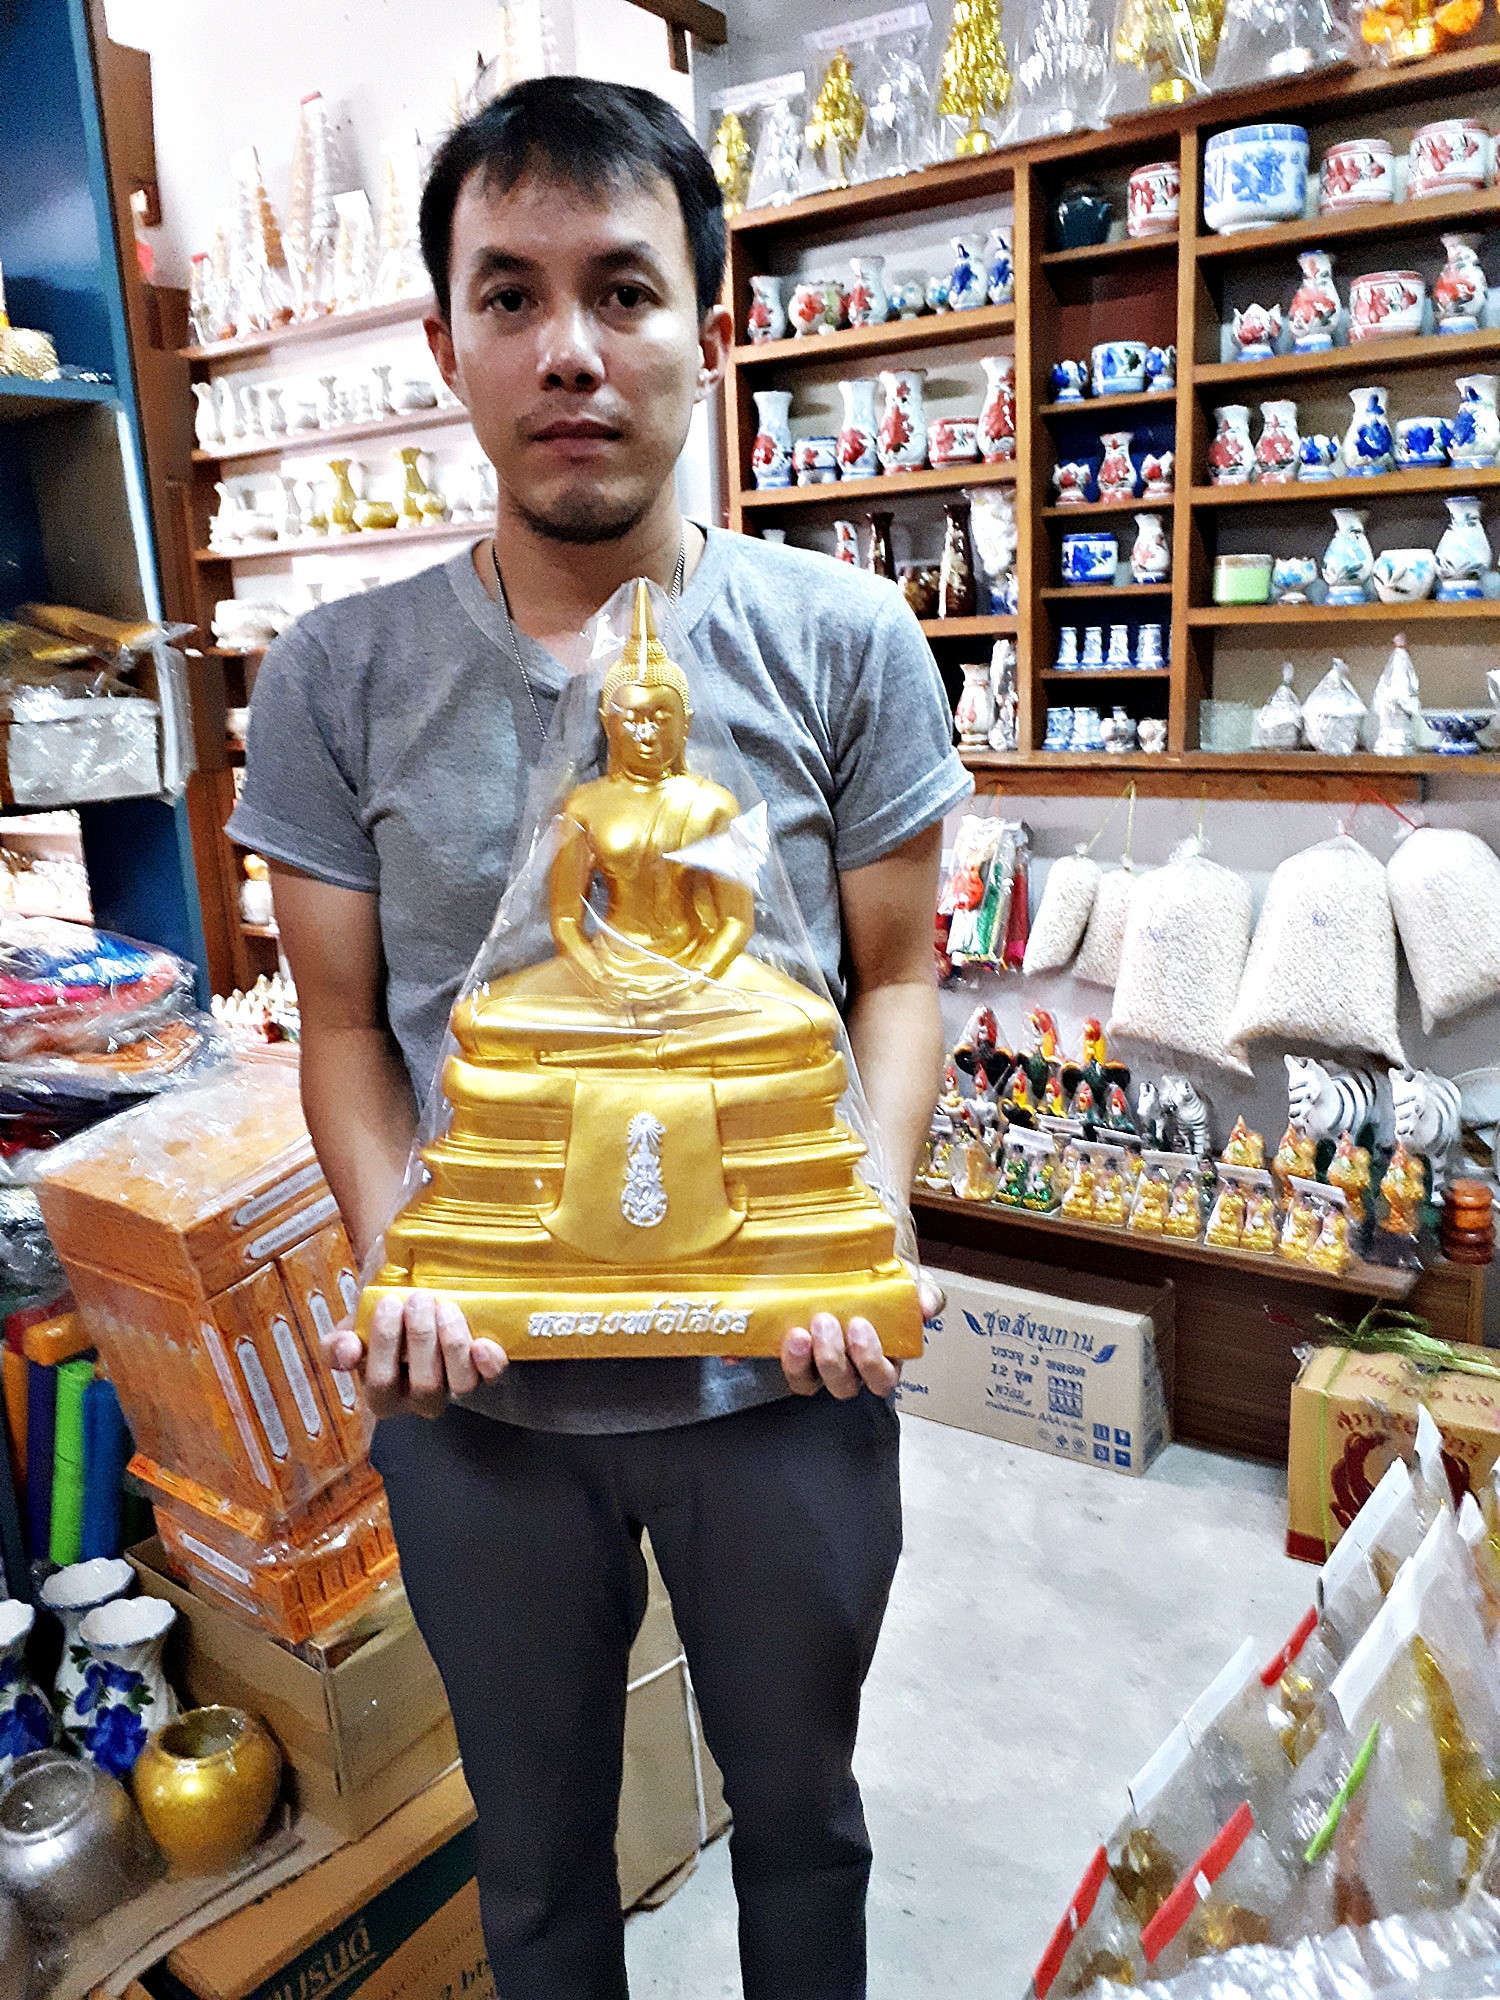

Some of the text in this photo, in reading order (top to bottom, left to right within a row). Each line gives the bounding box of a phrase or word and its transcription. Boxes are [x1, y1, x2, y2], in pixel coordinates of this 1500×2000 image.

[983, 1309, 1094, 1353] ชุดสังฆทาน
[990, 1345, 1024, 1367] บรรจุ
[990, 1363, 1033, 1385] 12 ชุด
